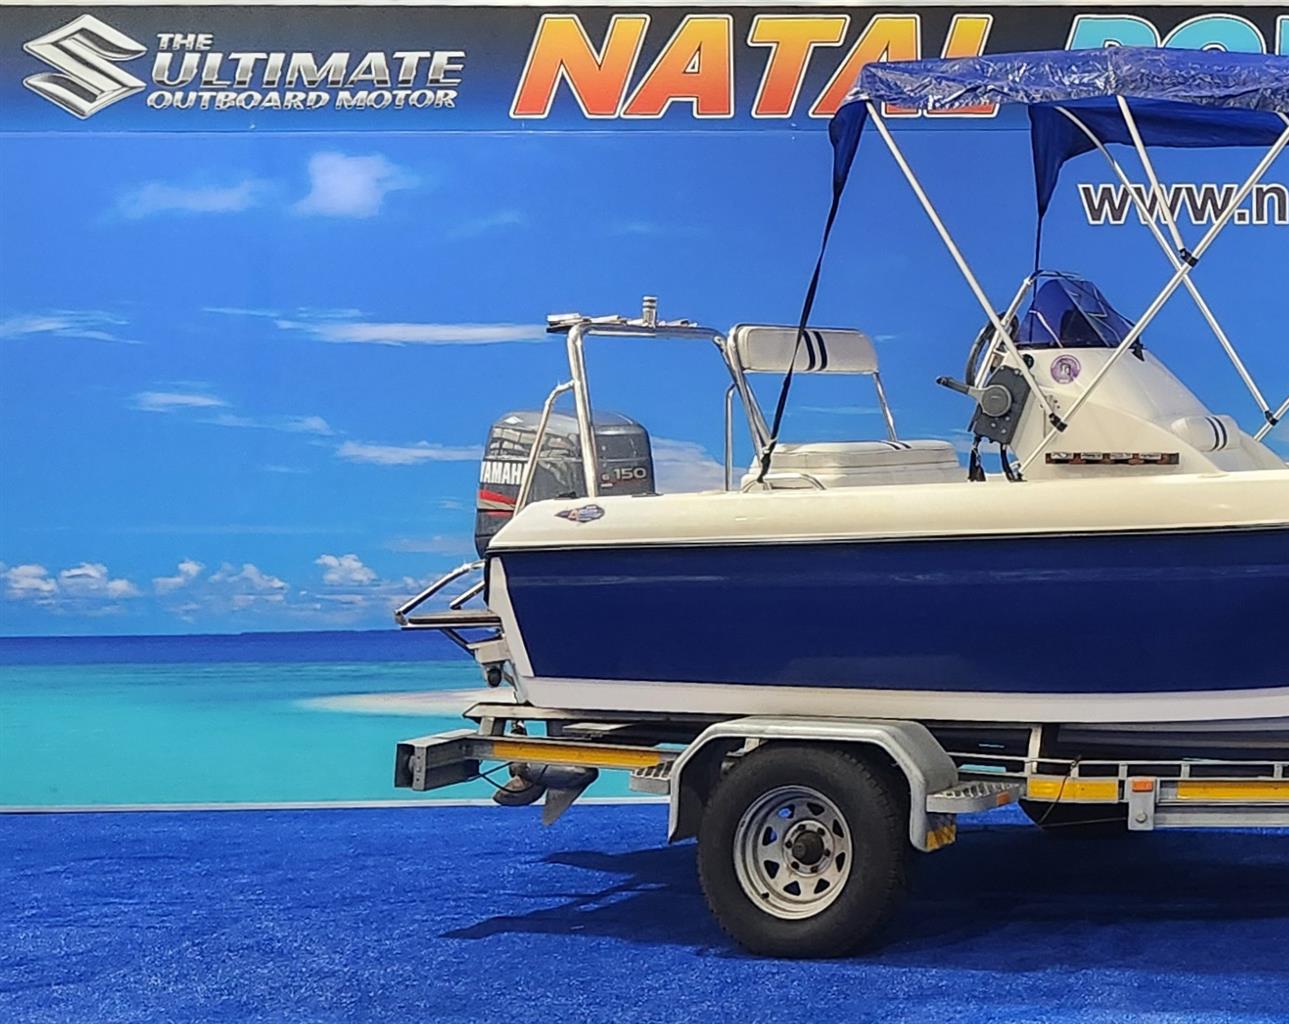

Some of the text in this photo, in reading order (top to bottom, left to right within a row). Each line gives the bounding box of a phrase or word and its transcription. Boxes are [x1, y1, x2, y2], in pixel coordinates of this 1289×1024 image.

[157, 33, 214, 50] THE
[151, 51, 466, 88] ULTIMATE
[146, 89, 458, 110] OUTBOARD MOTOR
[614, 467, 647, 480] 150
